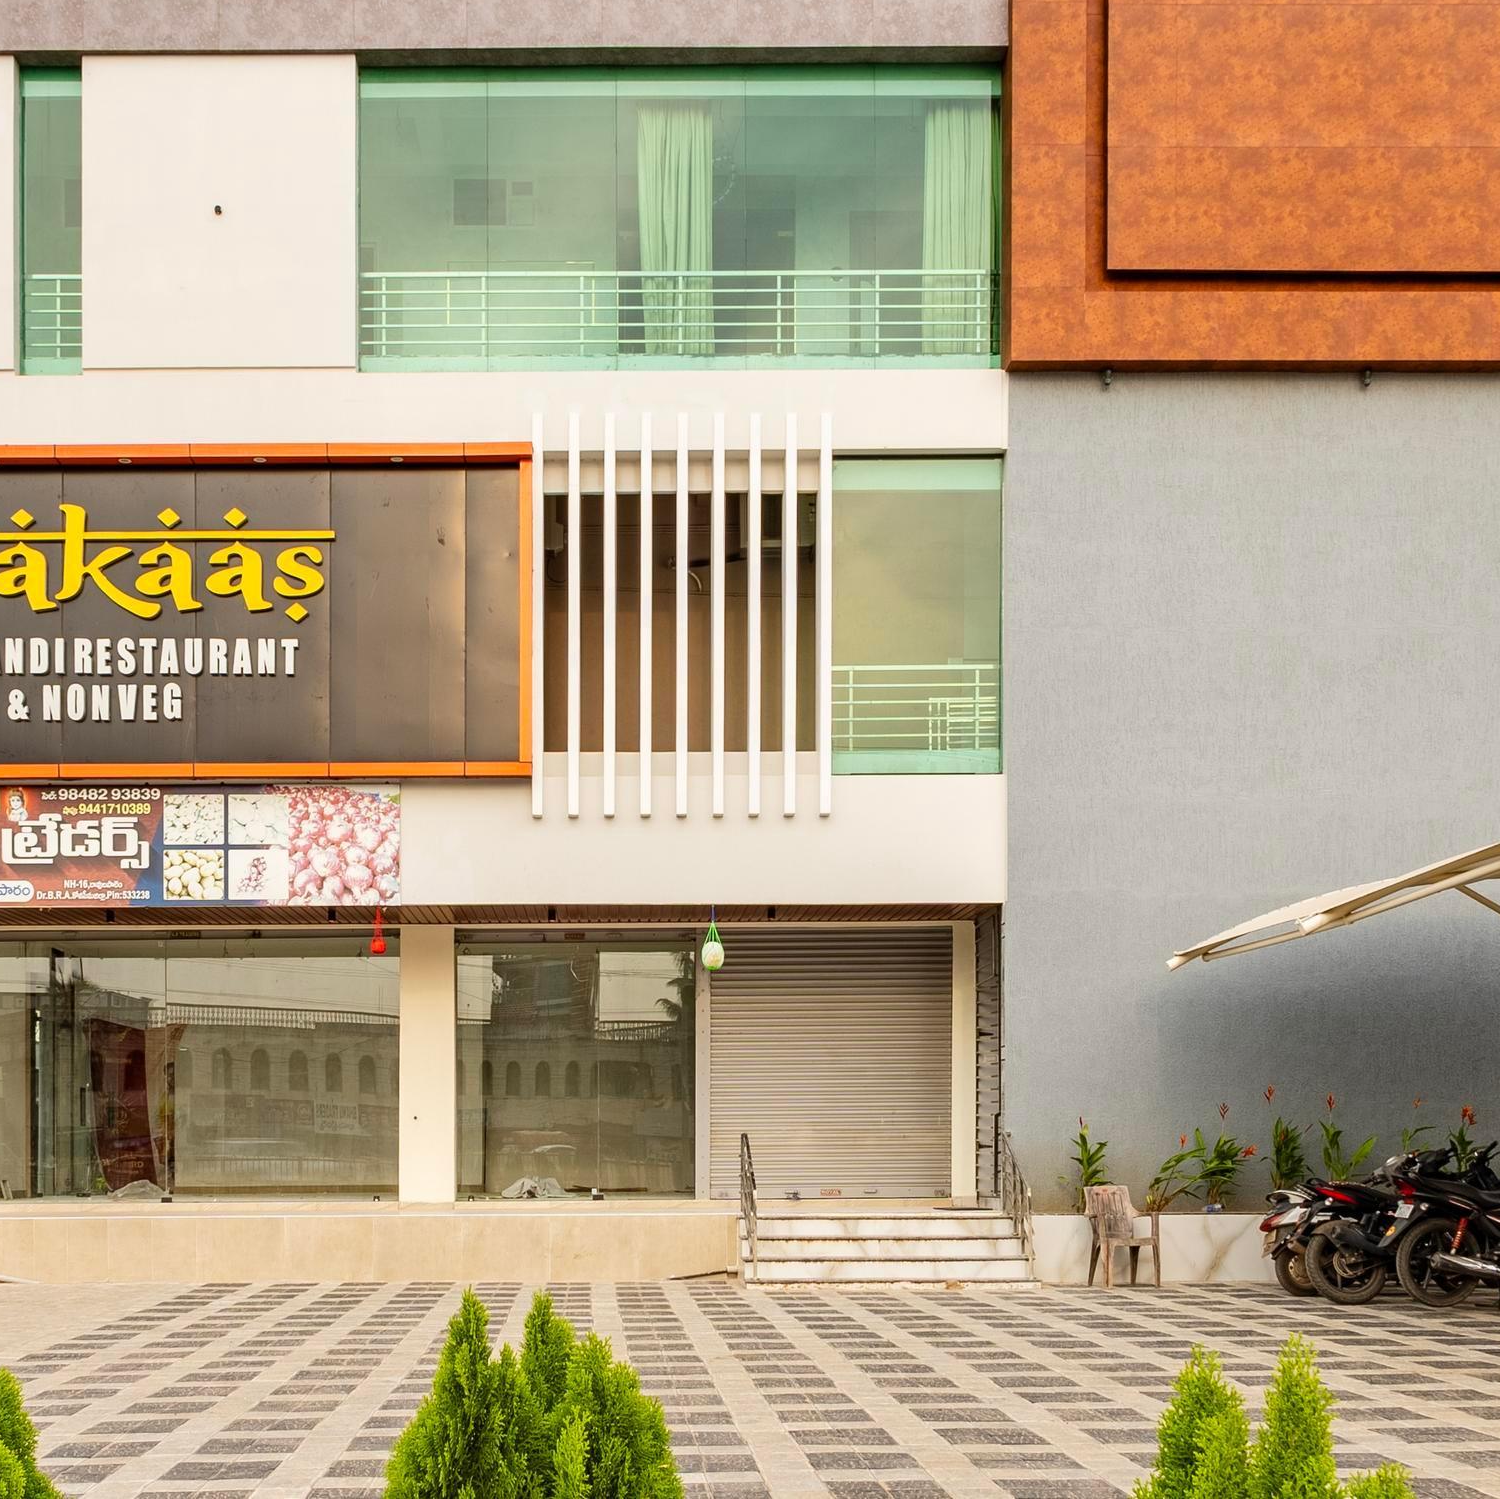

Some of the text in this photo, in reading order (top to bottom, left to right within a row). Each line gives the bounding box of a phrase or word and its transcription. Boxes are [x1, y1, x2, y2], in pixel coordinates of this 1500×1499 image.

[6, 683, 30, 722] &
[58, 788, 108, 801] 98482
[110, 788, 161, 801] 93839
[78, 803, 151, 815] 9441710389
[1, 813, 151, 870] ట్రేడర్స్
